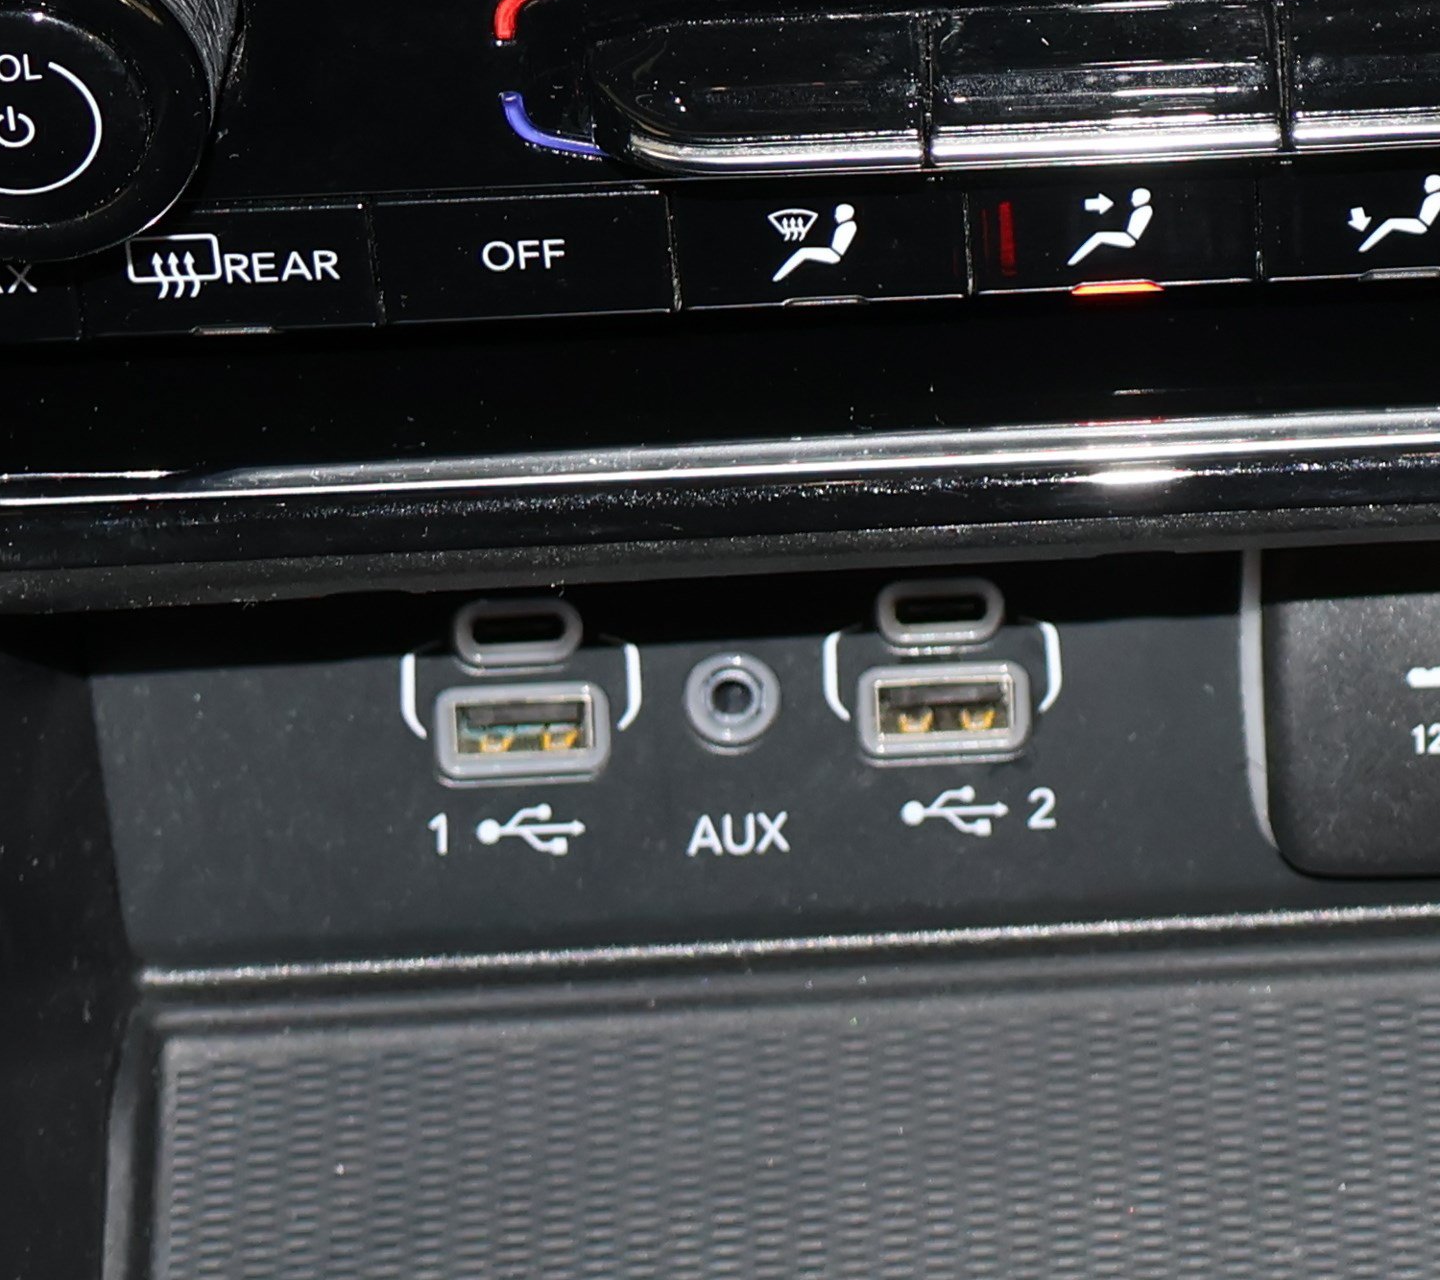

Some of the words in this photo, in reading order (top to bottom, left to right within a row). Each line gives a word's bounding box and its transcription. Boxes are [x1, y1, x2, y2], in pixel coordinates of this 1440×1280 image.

[223, 250, 340, 284] REAR
[482, 238, 565, 271] OFF
[1027, 787, 1056, 829] 2
[429, 813, 448, 854] 1
[687, 811, 789, 856] AUX
